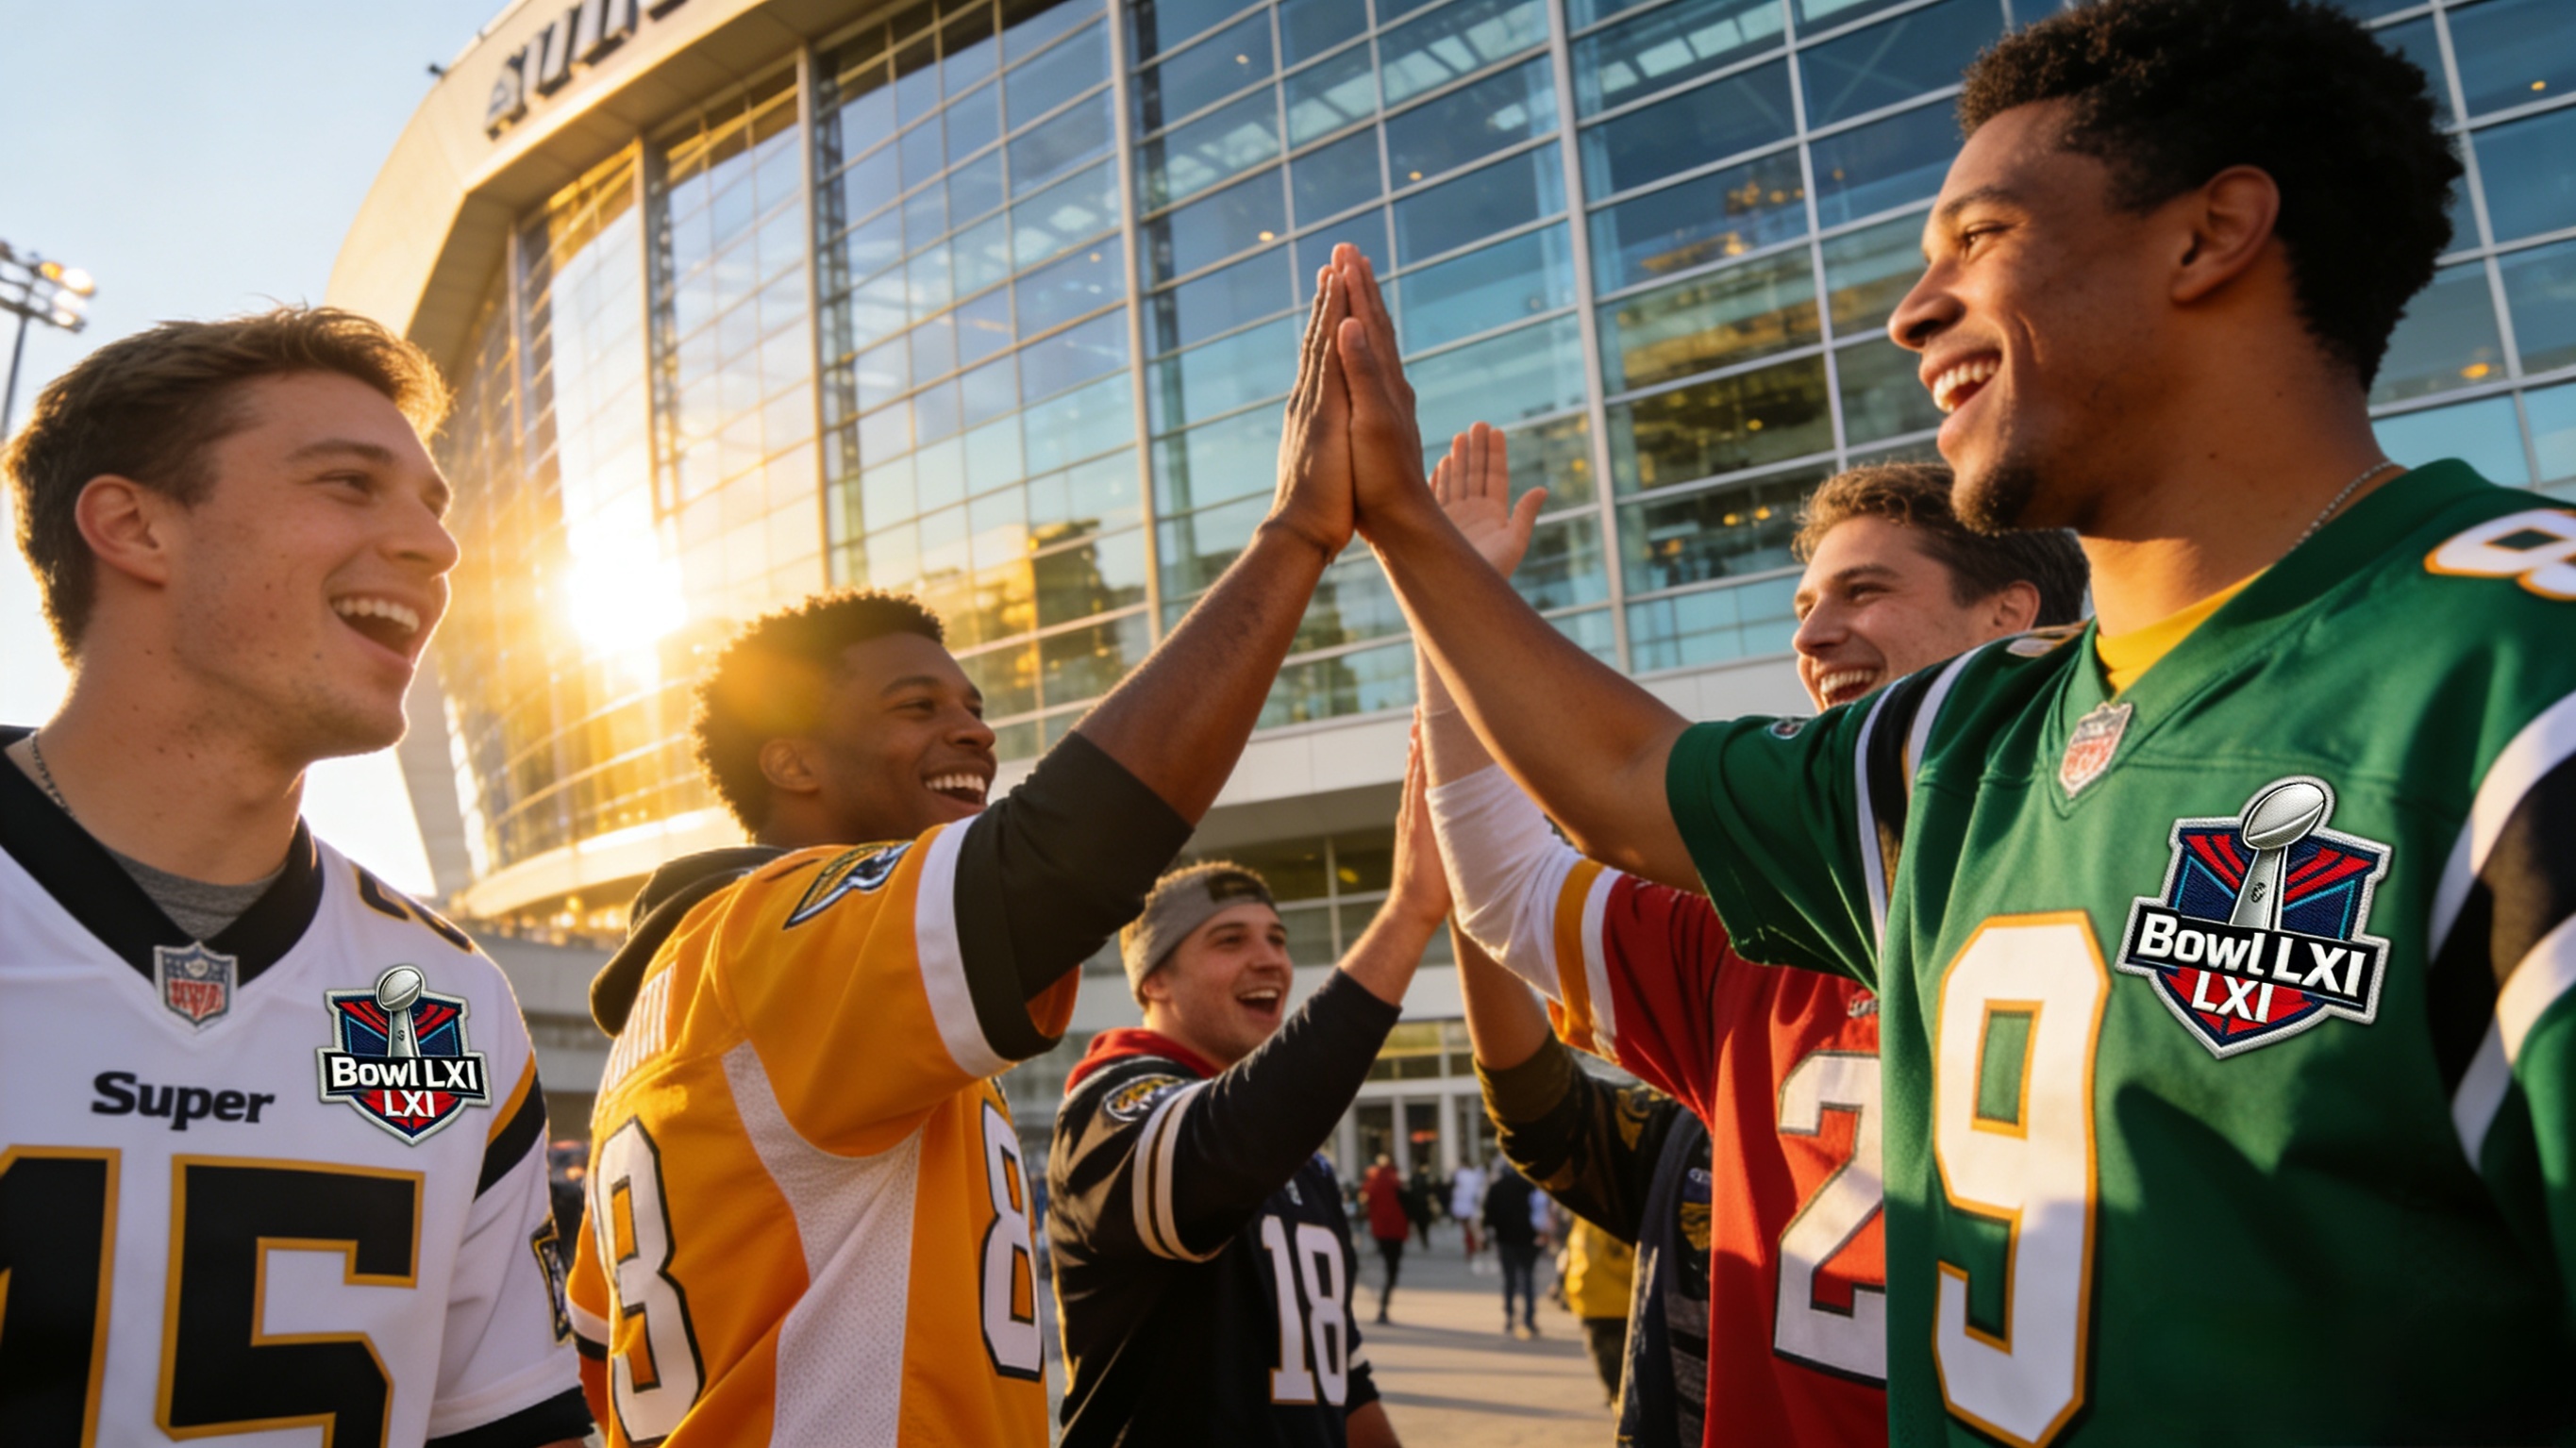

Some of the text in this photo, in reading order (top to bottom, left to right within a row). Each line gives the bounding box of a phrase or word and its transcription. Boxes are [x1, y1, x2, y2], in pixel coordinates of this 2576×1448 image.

[2136, 912, 2367, 997] Bowl LXI
[2191, 970, 2274, 1024] LXI
[91, 1071, 276, 1131] Super
[331, 1057, 478, 1090] Bowl LXI
[383, 1090, 436, 1118] LXI
[1932, 908, 2111, 1448] 9
[979, 1097, 1045, 1385] 8
[0, 1143, 425, 1448] 15
[1261, 1213, 1348, 1406] 18
